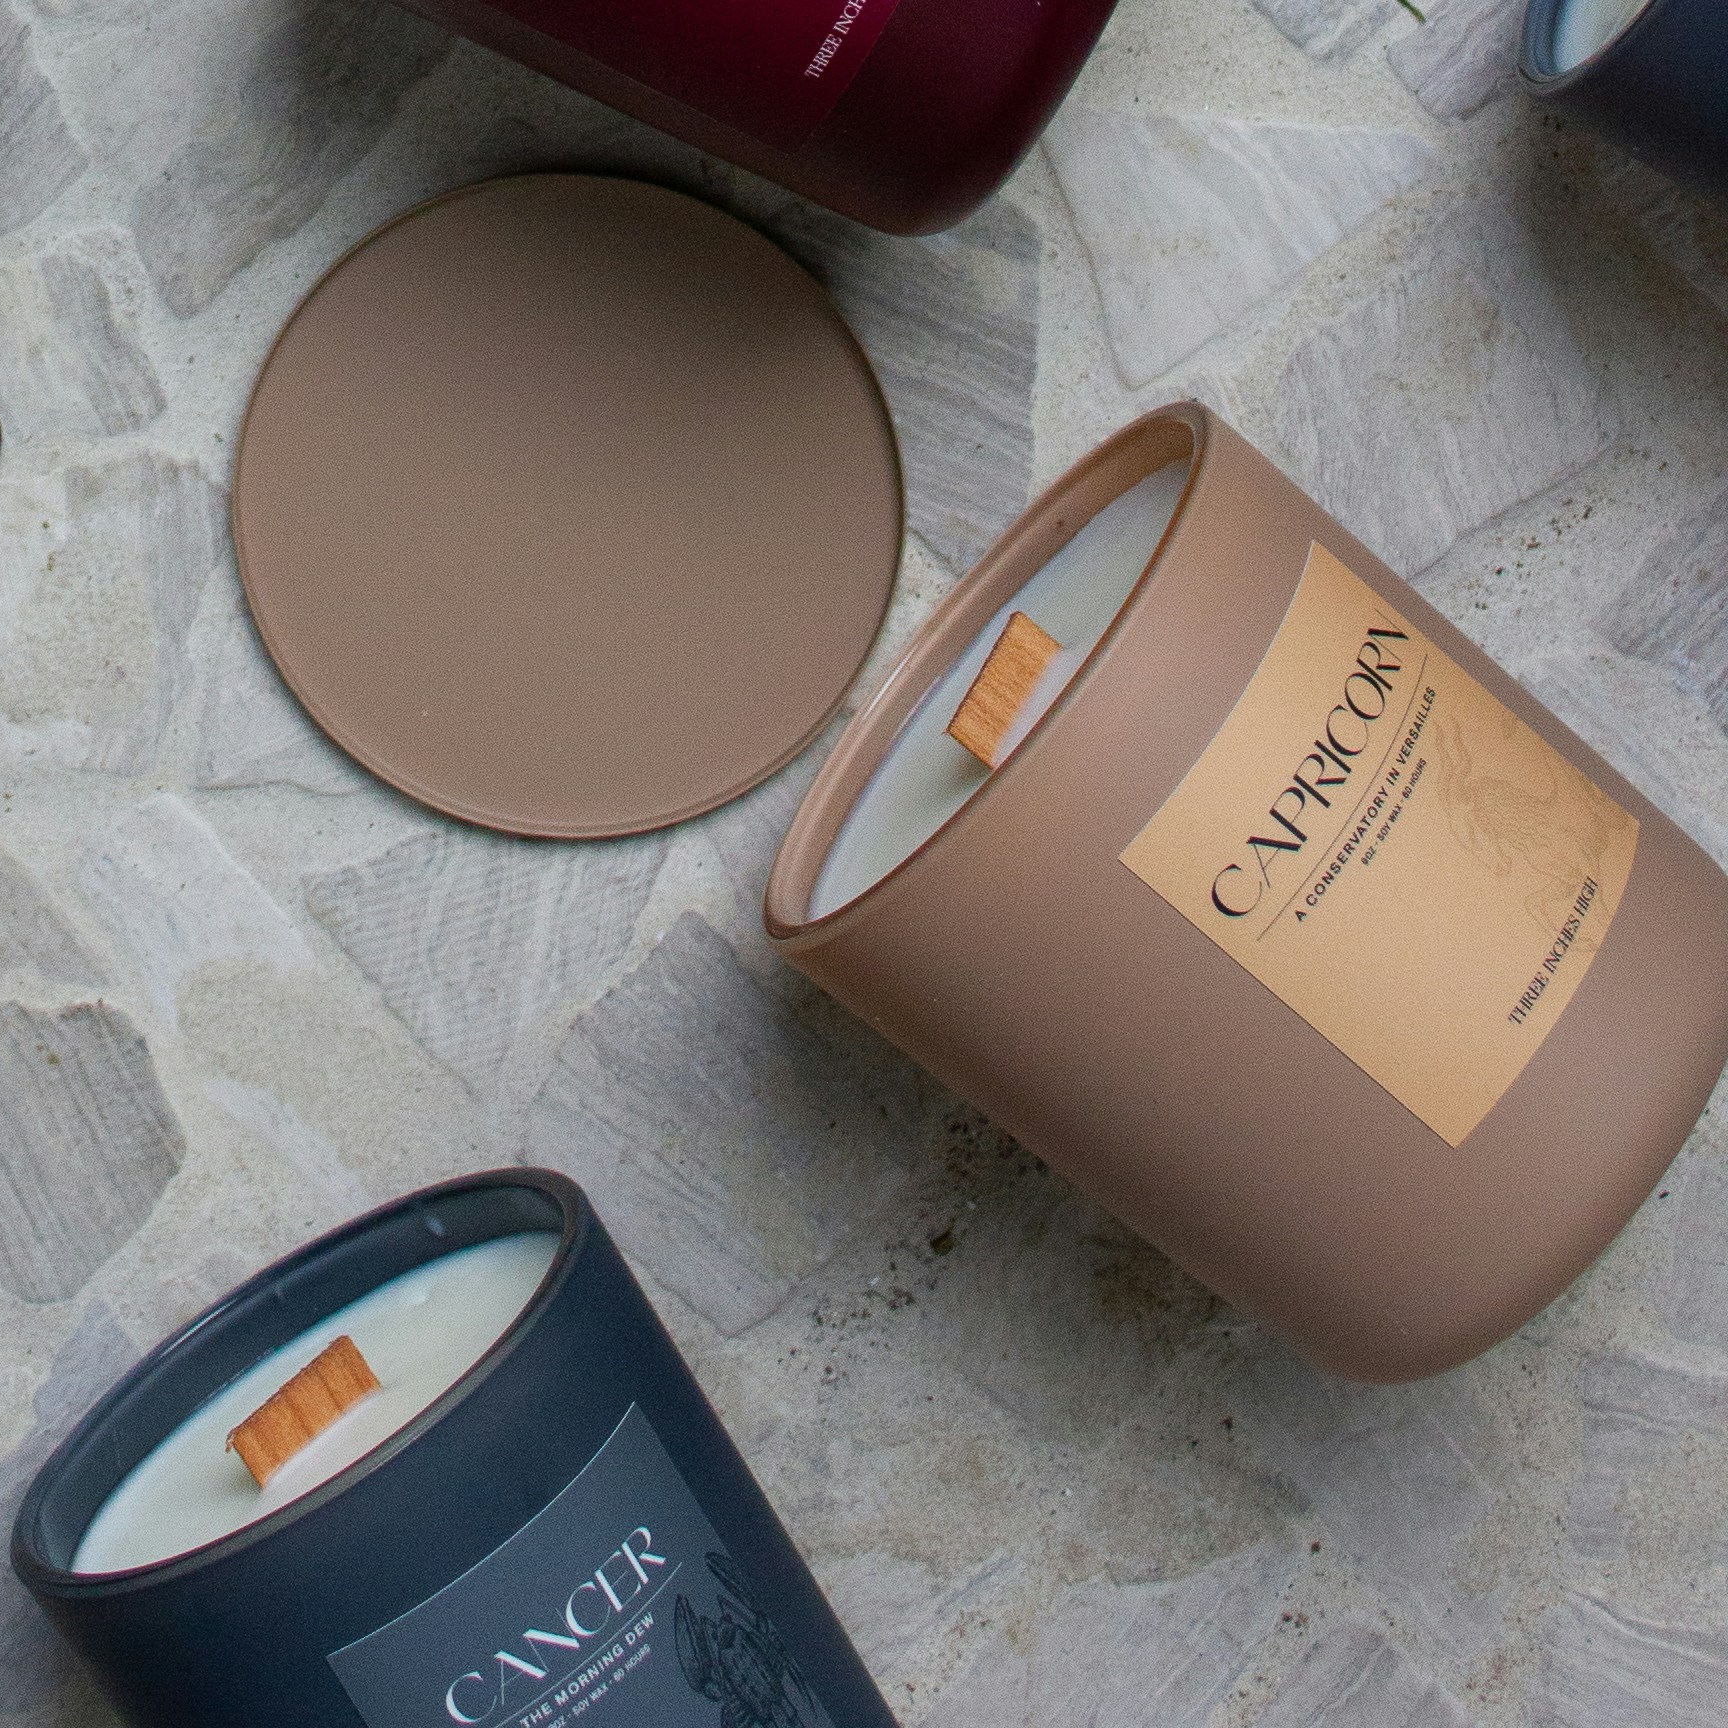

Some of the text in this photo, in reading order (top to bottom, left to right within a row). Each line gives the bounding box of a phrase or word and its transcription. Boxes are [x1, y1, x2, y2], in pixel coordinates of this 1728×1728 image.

[803, 33, 843, 79] THREE
[1210, 610, 1411, 919] CAPRICORN
[1294, 686, 1437, 923] A CONSERVATORY IN VERSAILLES
[1507, 875, 1599, 1025] THREE INCHES HIGH
[445, 1526, 666, 1724] CANCER
[519, 1612, 655, 1728] THE MORNING DEW
